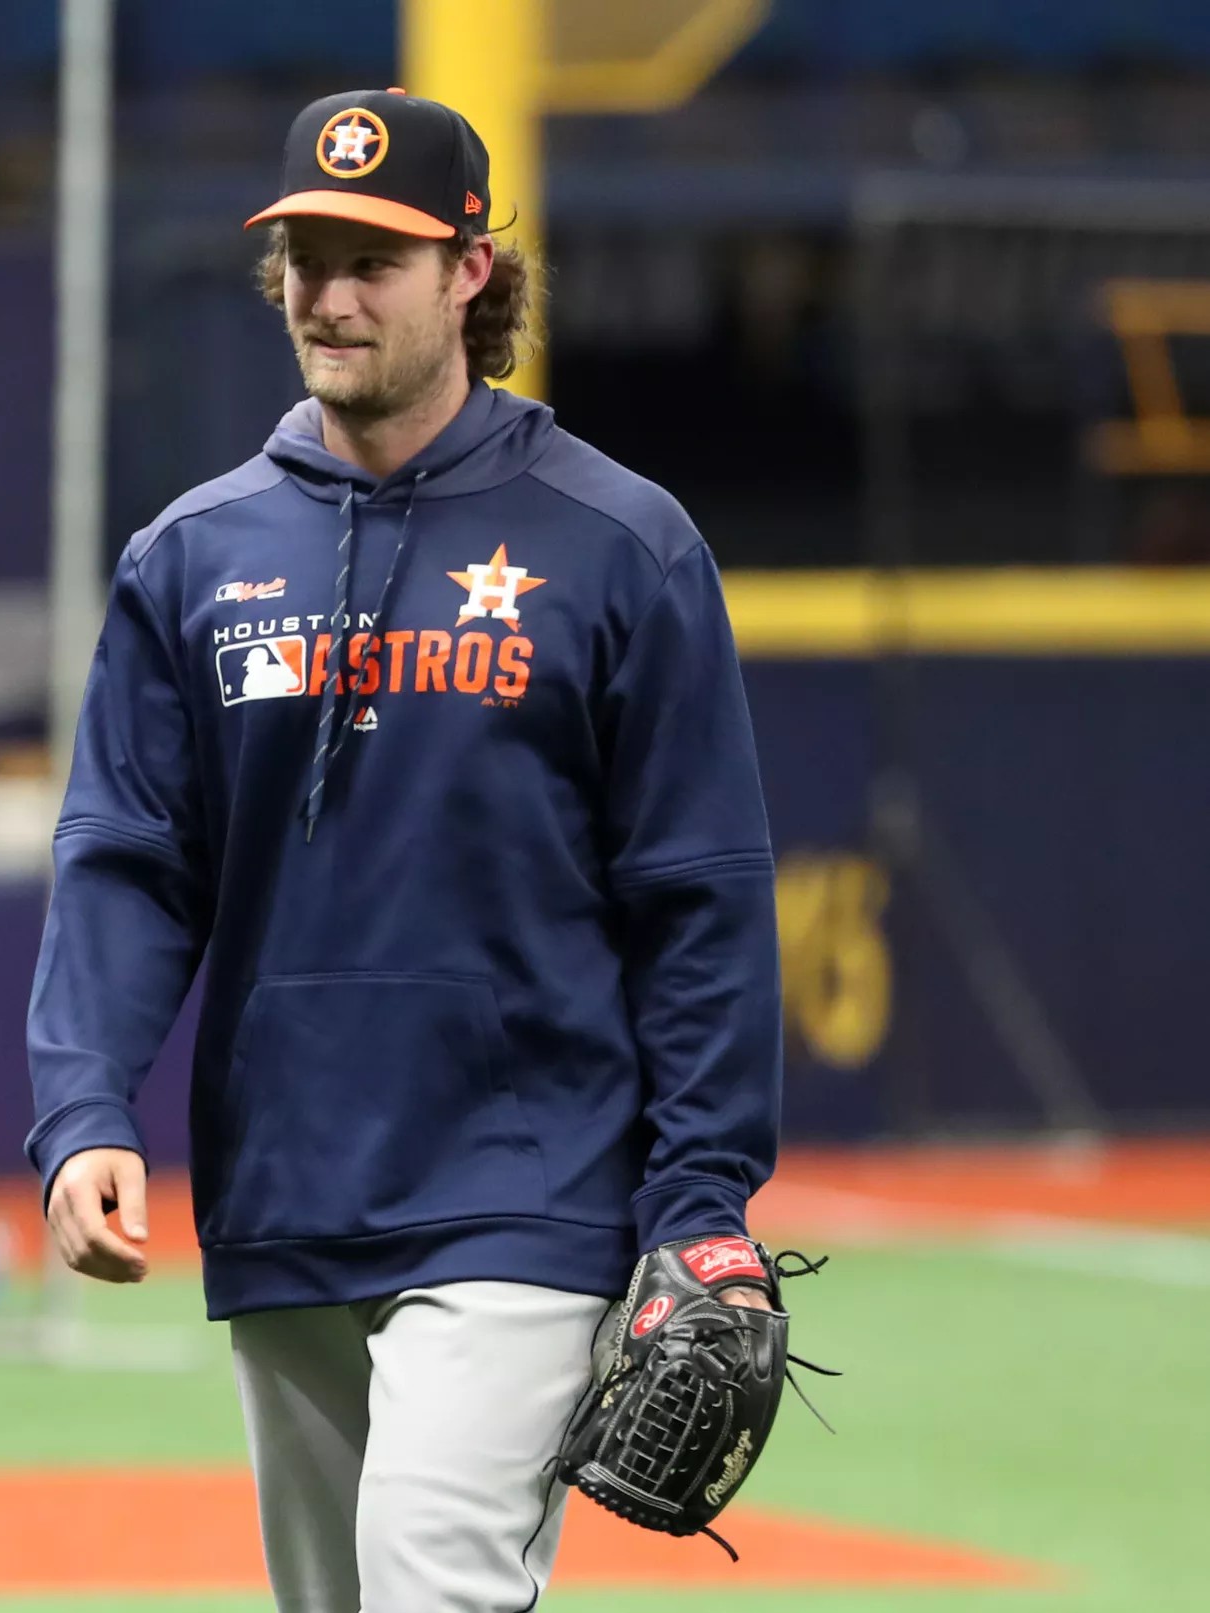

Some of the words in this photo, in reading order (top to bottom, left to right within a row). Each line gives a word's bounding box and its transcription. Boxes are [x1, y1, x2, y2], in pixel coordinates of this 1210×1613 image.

[329, 125, 372, 161] H
[459, 563, 528, 620] H
[213, 612, 380, 645] HOUSTON
[307, 629, 534, 698] ASTROS
[704, 1428, 754, 1507] Rawlings
